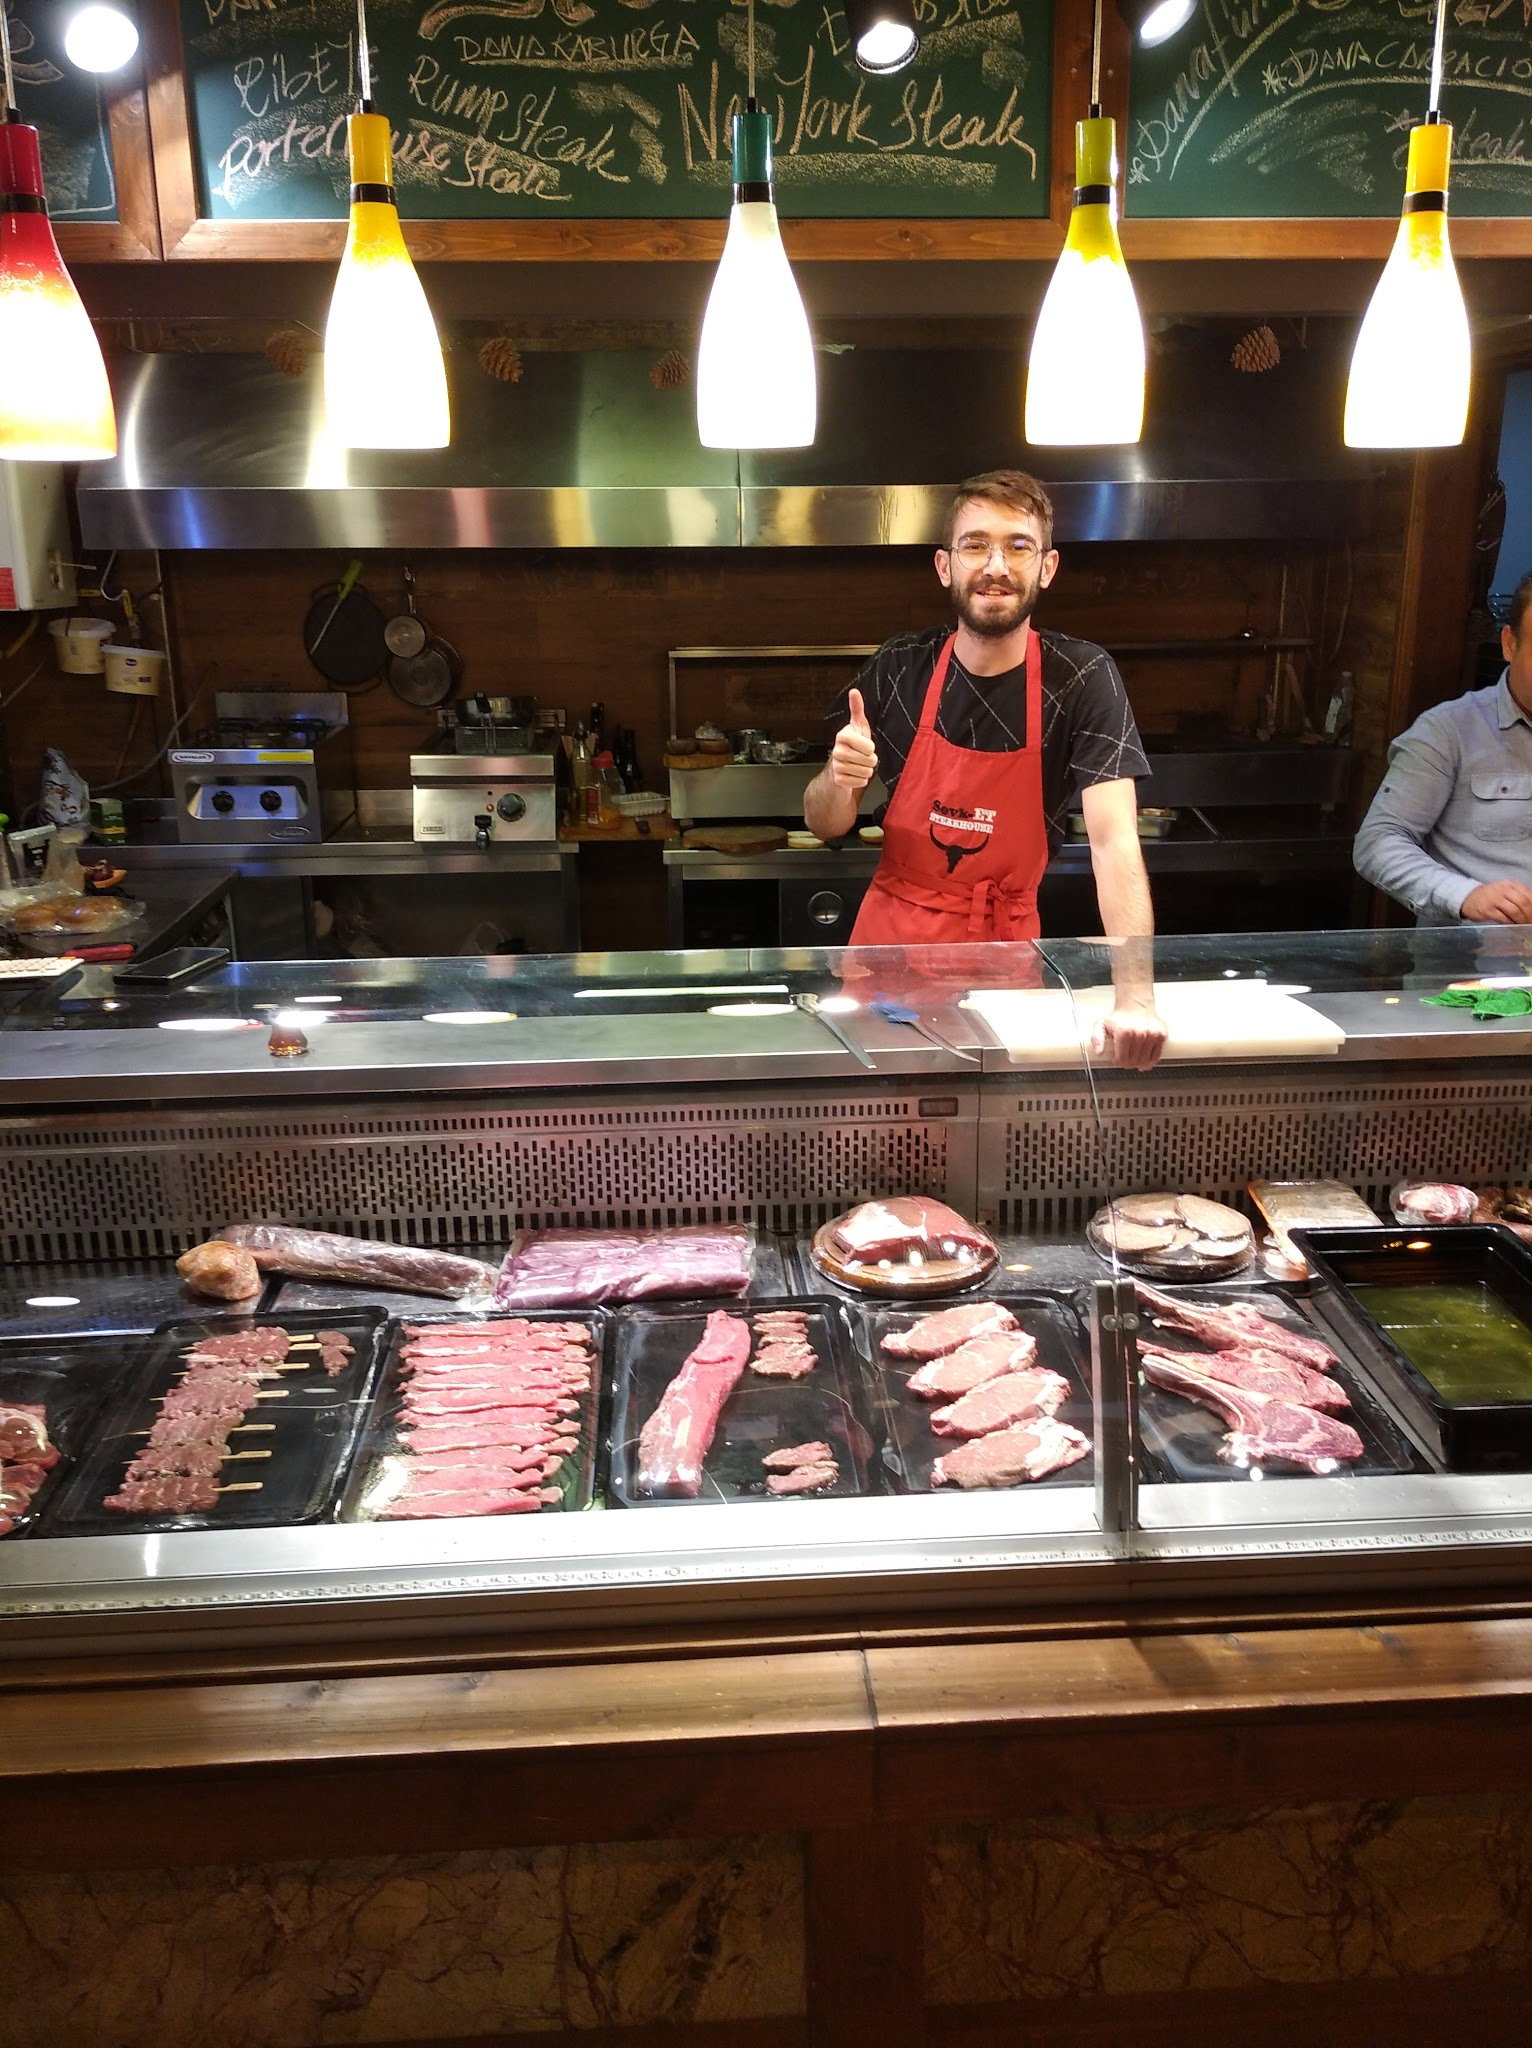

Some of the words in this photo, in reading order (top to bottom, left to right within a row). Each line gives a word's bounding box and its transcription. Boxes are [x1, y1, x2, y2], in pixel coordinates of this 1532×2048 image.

[453, 35, 547, 62] DANA
[551, 20, 701, 64] KABURGA
[1281, 40, 1371, 88] DANA
[408, 54, 509, 135] Rump
[499, 86, 631, 184] Steak
[928, 811, 995, 835] STEAKHOUSE
